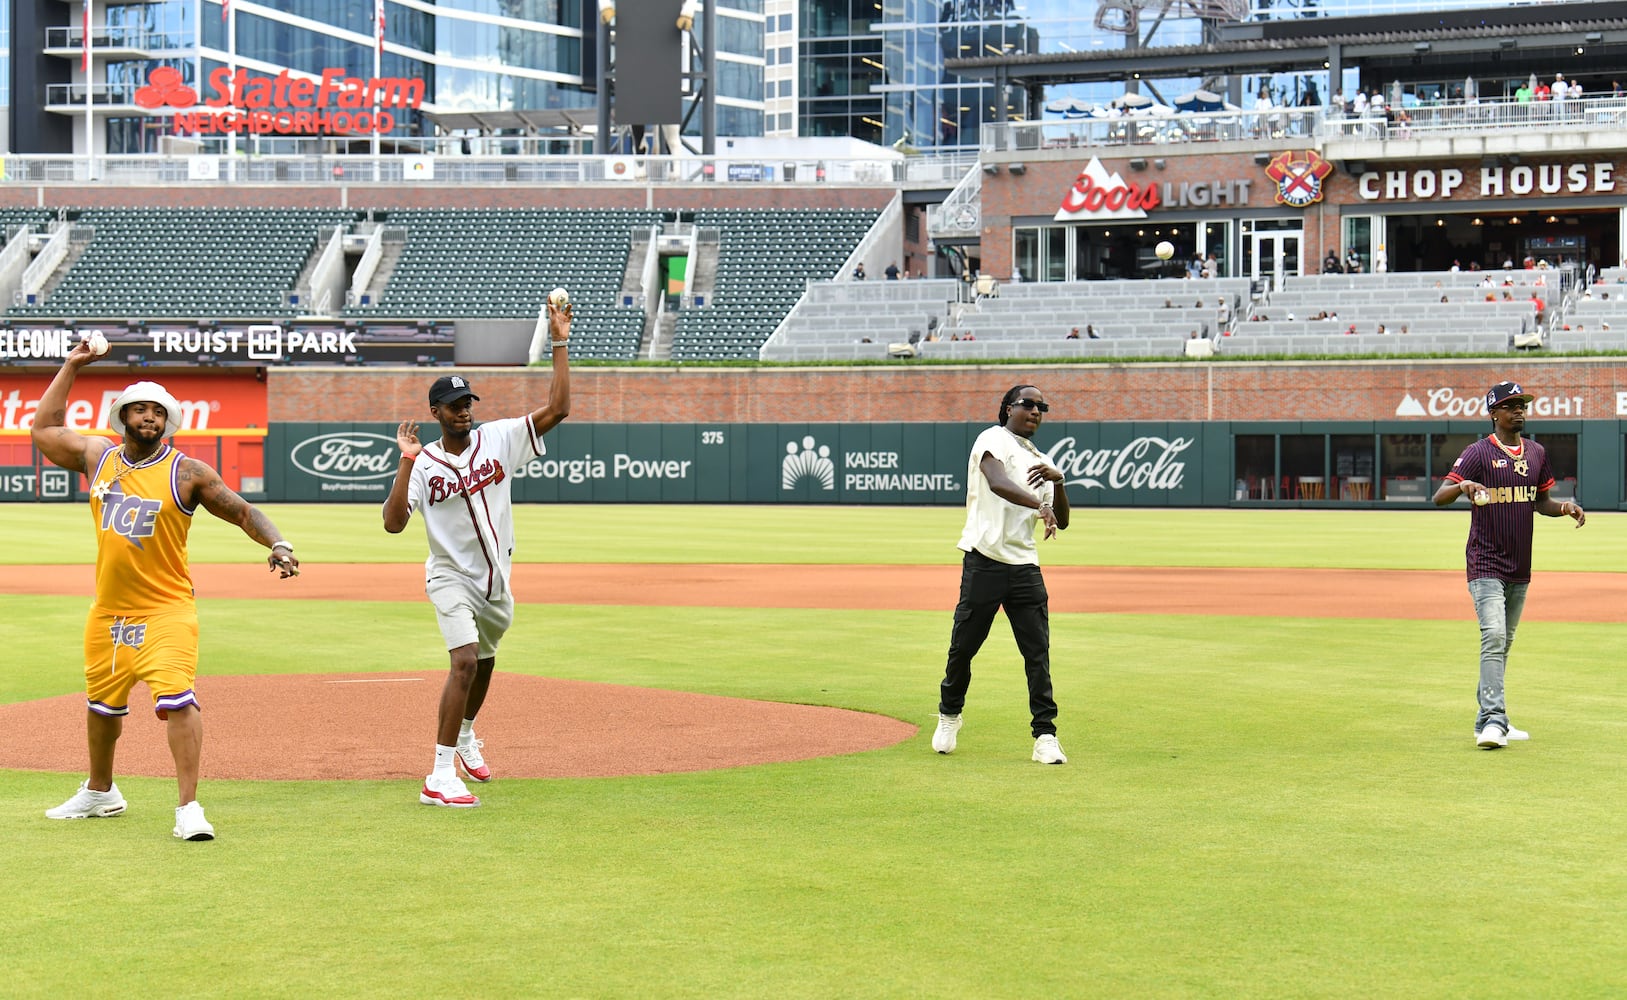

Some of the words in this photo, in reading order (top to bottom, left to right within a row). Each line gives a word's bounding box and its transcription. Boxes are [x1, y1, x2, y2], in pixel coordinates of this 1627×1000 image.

[173, 111, 394, 135] NEIGHBORHOOD
[1061, 173, 1161, 212] Coors
[1162, 178, 1253, 208] LIGHT
[1359, 168, 1463, 200] CHOP
[1480, 162, 1615, 196] HOUSE
[0, 329, 72, 358] ELCOME
[148, 331, 243, 353] TRUIST
[287, 331, 357, 353] PARK
[1427, 387, 1489, 416] Coor
[1527, 396, 1584, 416] IGHT
[701, 431, 725, 445] 375
[312, 438, 394, 472] Ford
[613, 453, 692, 478] Power
[845, 451, 899, 469] KAISER
[1045, 436, 1195, 489] Coca-Cola
[0, 475, 37, 493] UIST
[100, 491, 163, 538] TCE
[109, 623, 148, 646] TCE
